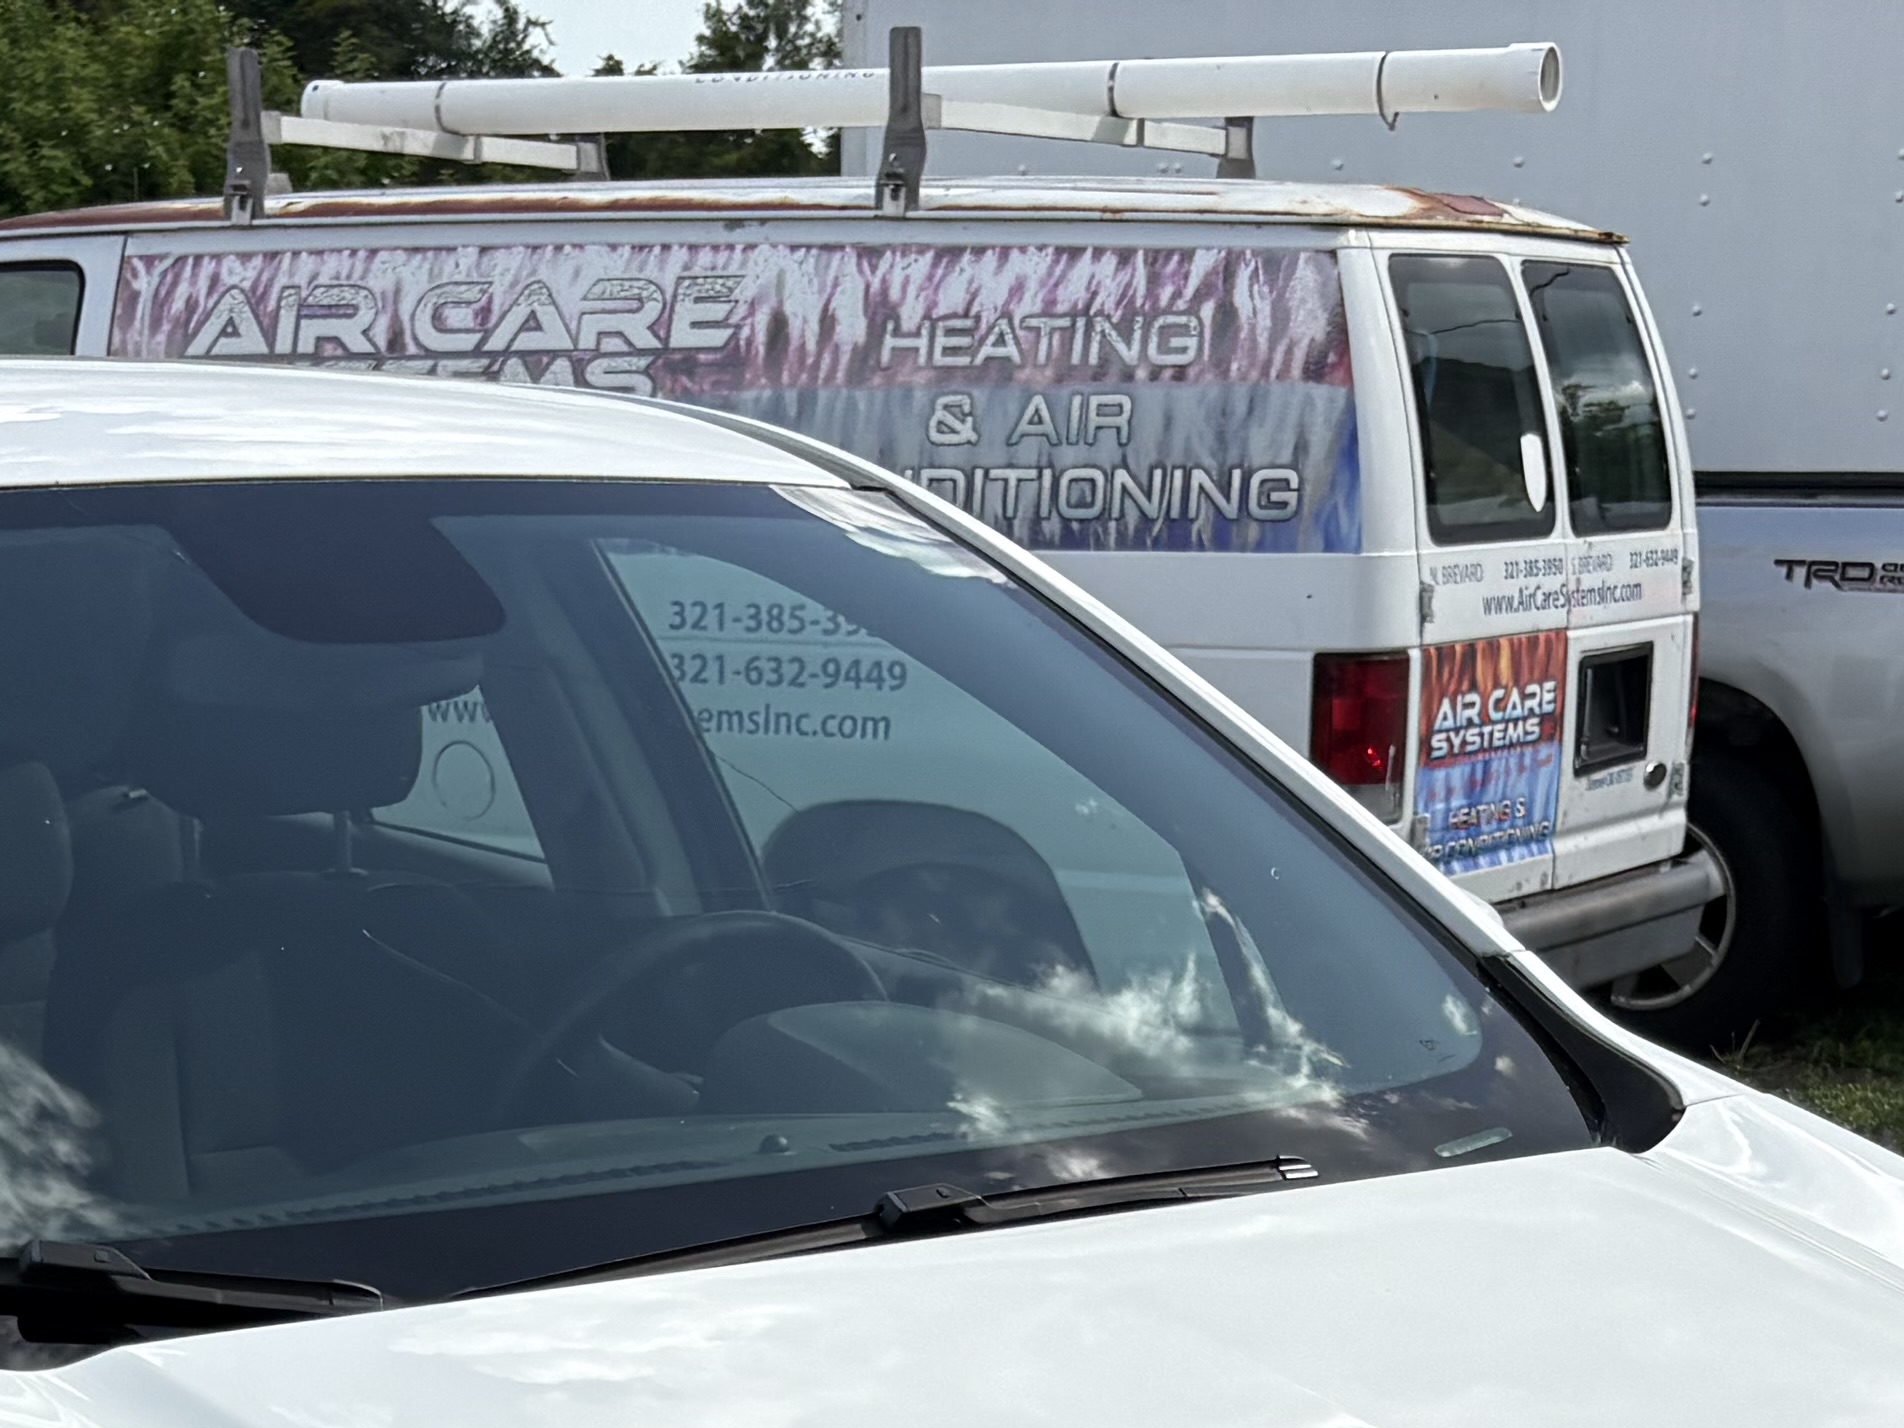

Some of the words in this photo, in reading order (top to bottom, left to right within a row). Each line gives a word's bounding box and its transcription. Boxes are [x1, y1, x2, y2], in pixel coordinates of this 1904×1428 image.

[184, 283, 382, 358] AIR
[413, 275, 746, 352] CARE
[879, 315, 1201, 368] HEATING
[927, 393, 980, 447] &
[1007, 393, 1133, 447] AIR
[902, 466, 1301, 521] DITIONING
[1773, 559, 1876, 591] TRD
[669, 653, 908, 691] 321-632-9449
[1433, 690, 1483, 733] AIR
[1487, 679, 1557, 721] CARE
[1429, 716, 1542, 760] SYSTEMS
